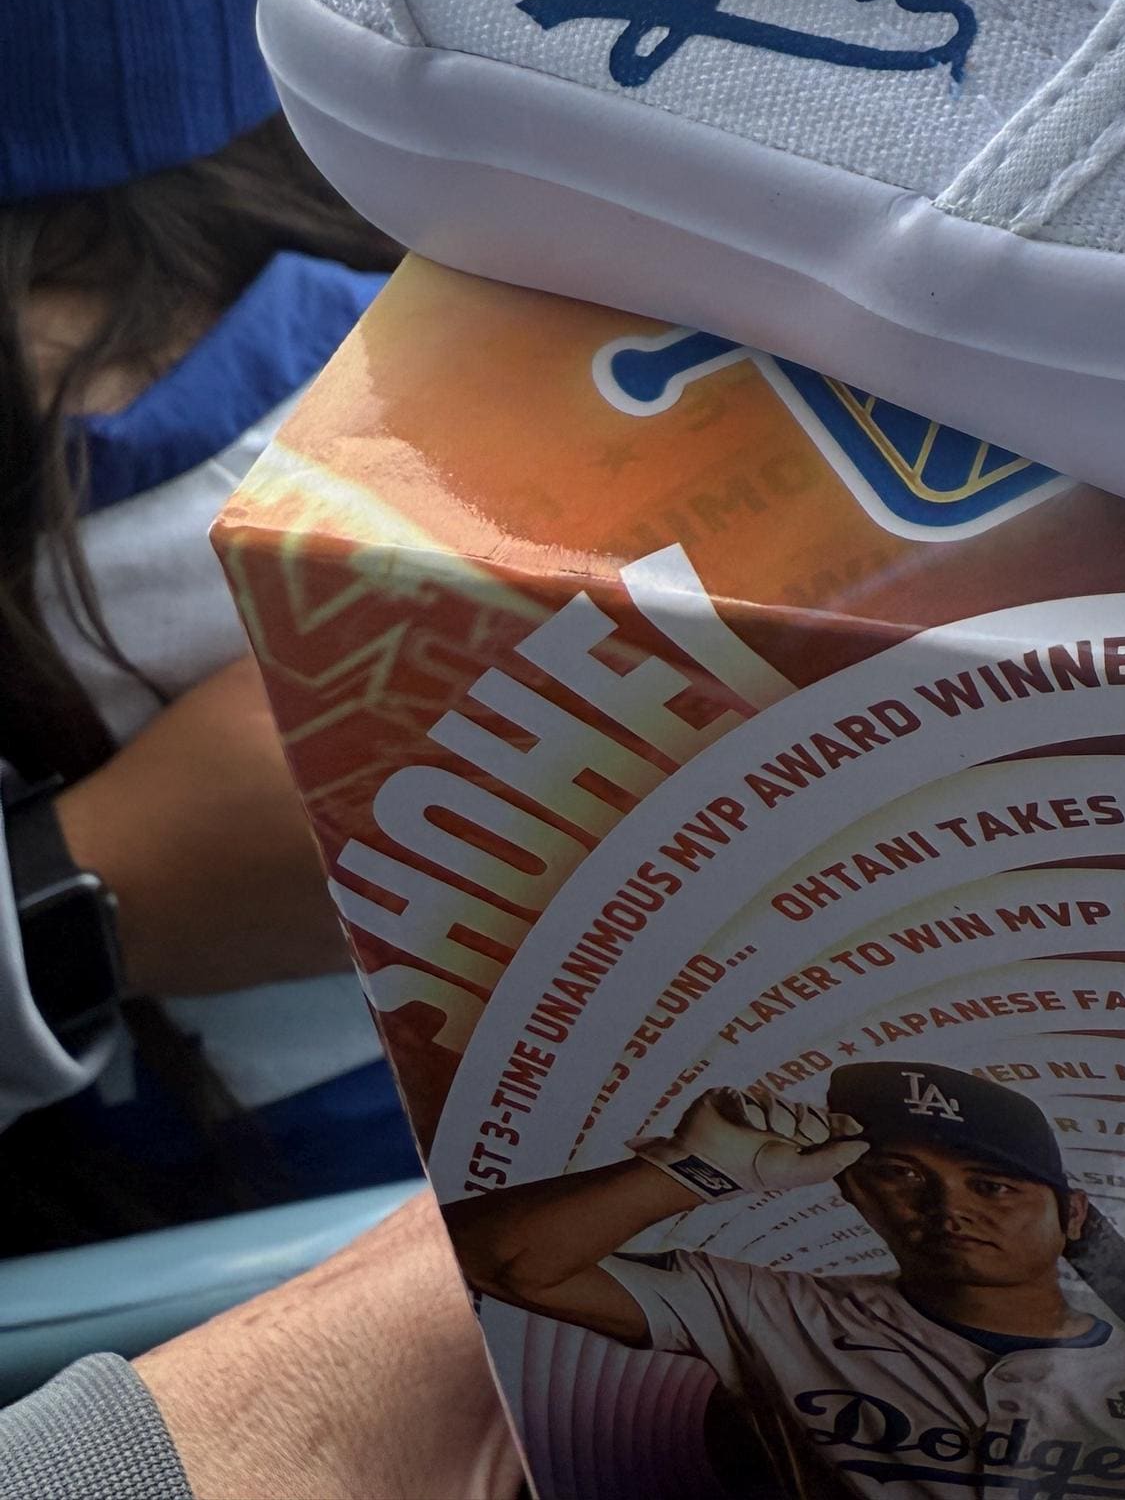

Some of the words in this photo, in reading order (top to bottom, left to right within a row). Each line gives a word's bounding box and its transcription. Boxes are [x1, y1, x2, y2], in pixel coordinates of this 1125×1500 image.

[771, 831, 941, 921] OHTANI
[938, 795, 1124, 847] TAKES
[479, 1040, 556, 1146] 3-TIME
[524, 861, 682, 1043] UNANIMOUS
[659, 797, 747, 872] MVP
[744, 699, 921, 808] AWARD
[831, 941, 895, 978] TO
[889, 912, 994, 954] WIN
[996, 901, 1110, 932] MVP
[861, 990, 1065, 1047] JAPANESE
[901, 1071, 964, 1122] LA
[1047, 1061, 1106, 1080] NL
